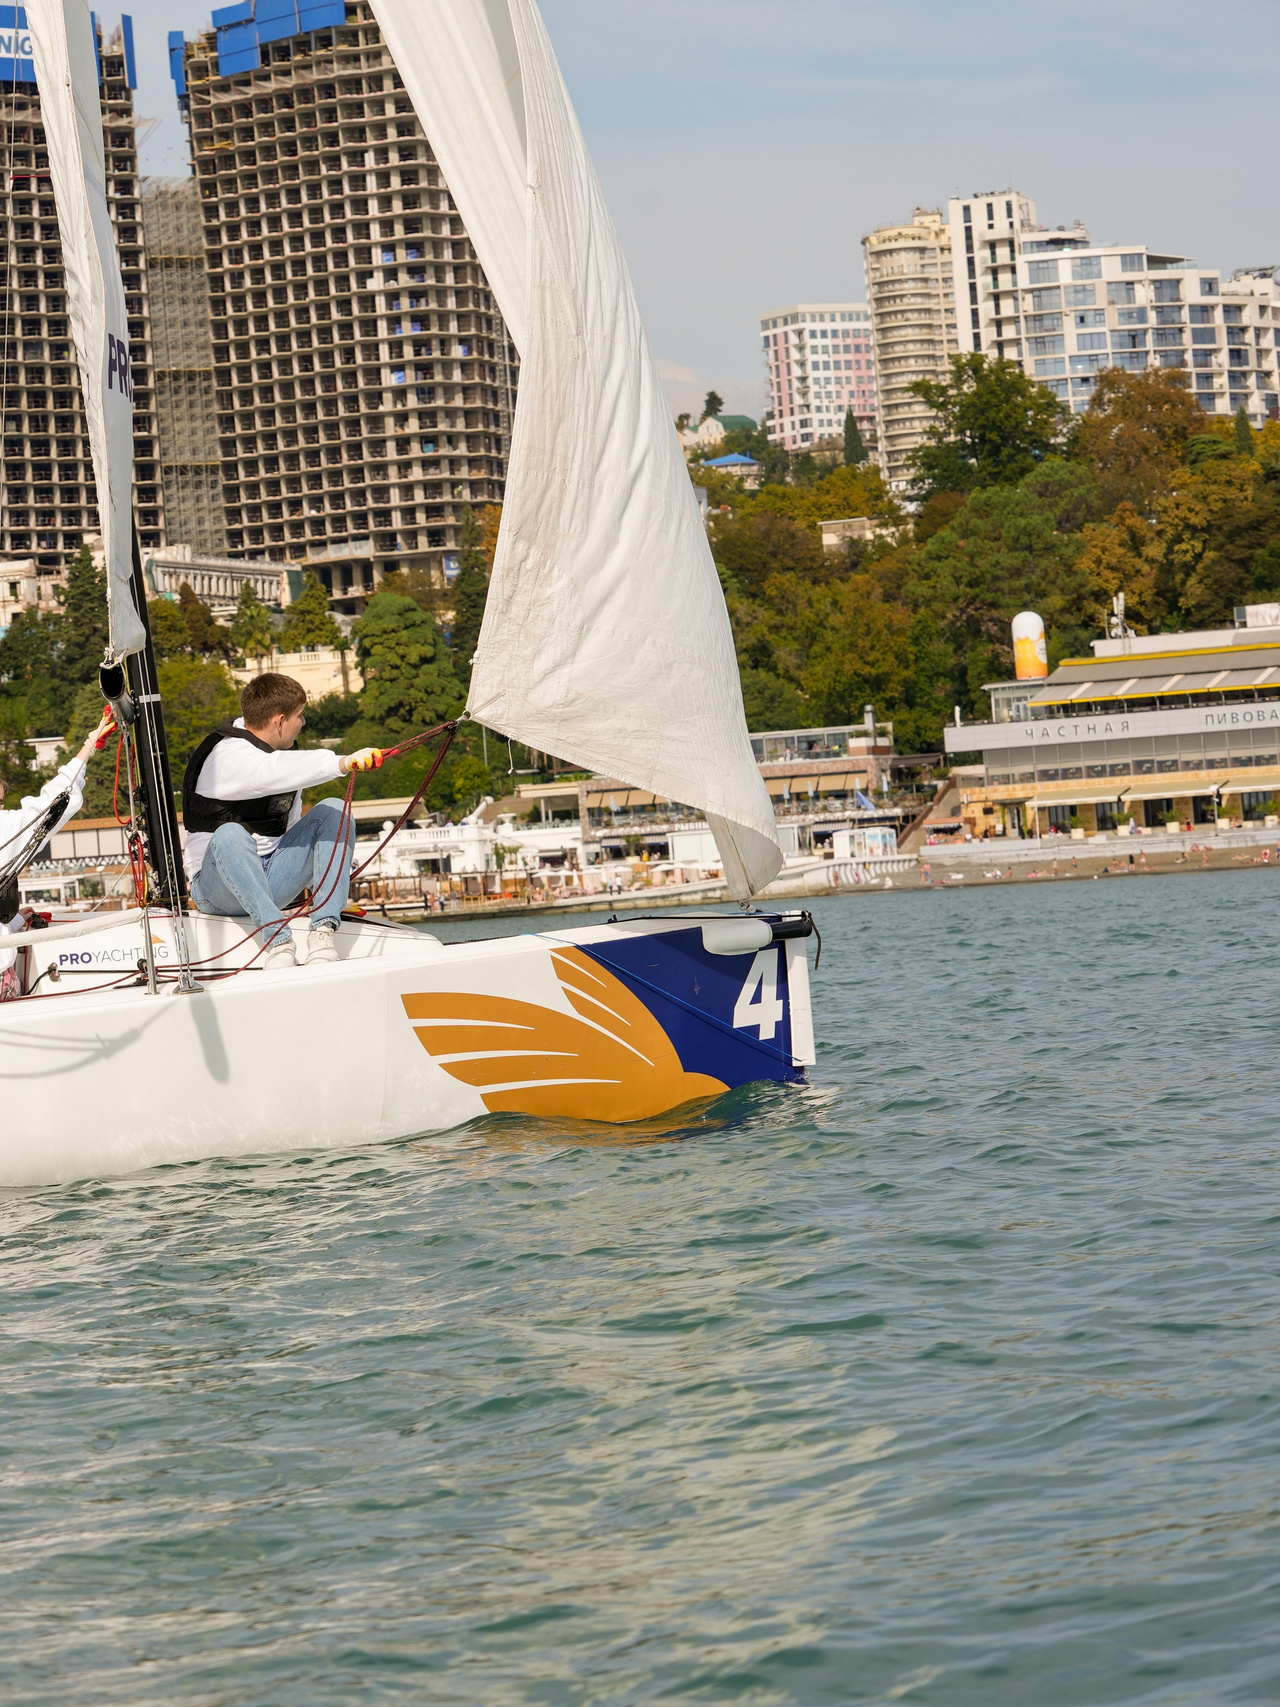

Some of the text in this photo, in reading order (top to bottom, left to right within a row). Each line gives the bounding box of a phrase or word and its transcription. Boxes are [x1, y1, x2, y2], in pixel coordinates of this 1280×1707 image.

[108, 332, 132, 403] PR
[1025, 709, 1280, 739] ЧАСТНАЯ ПИВОВА
[733, 948, 783, 1040] 4
